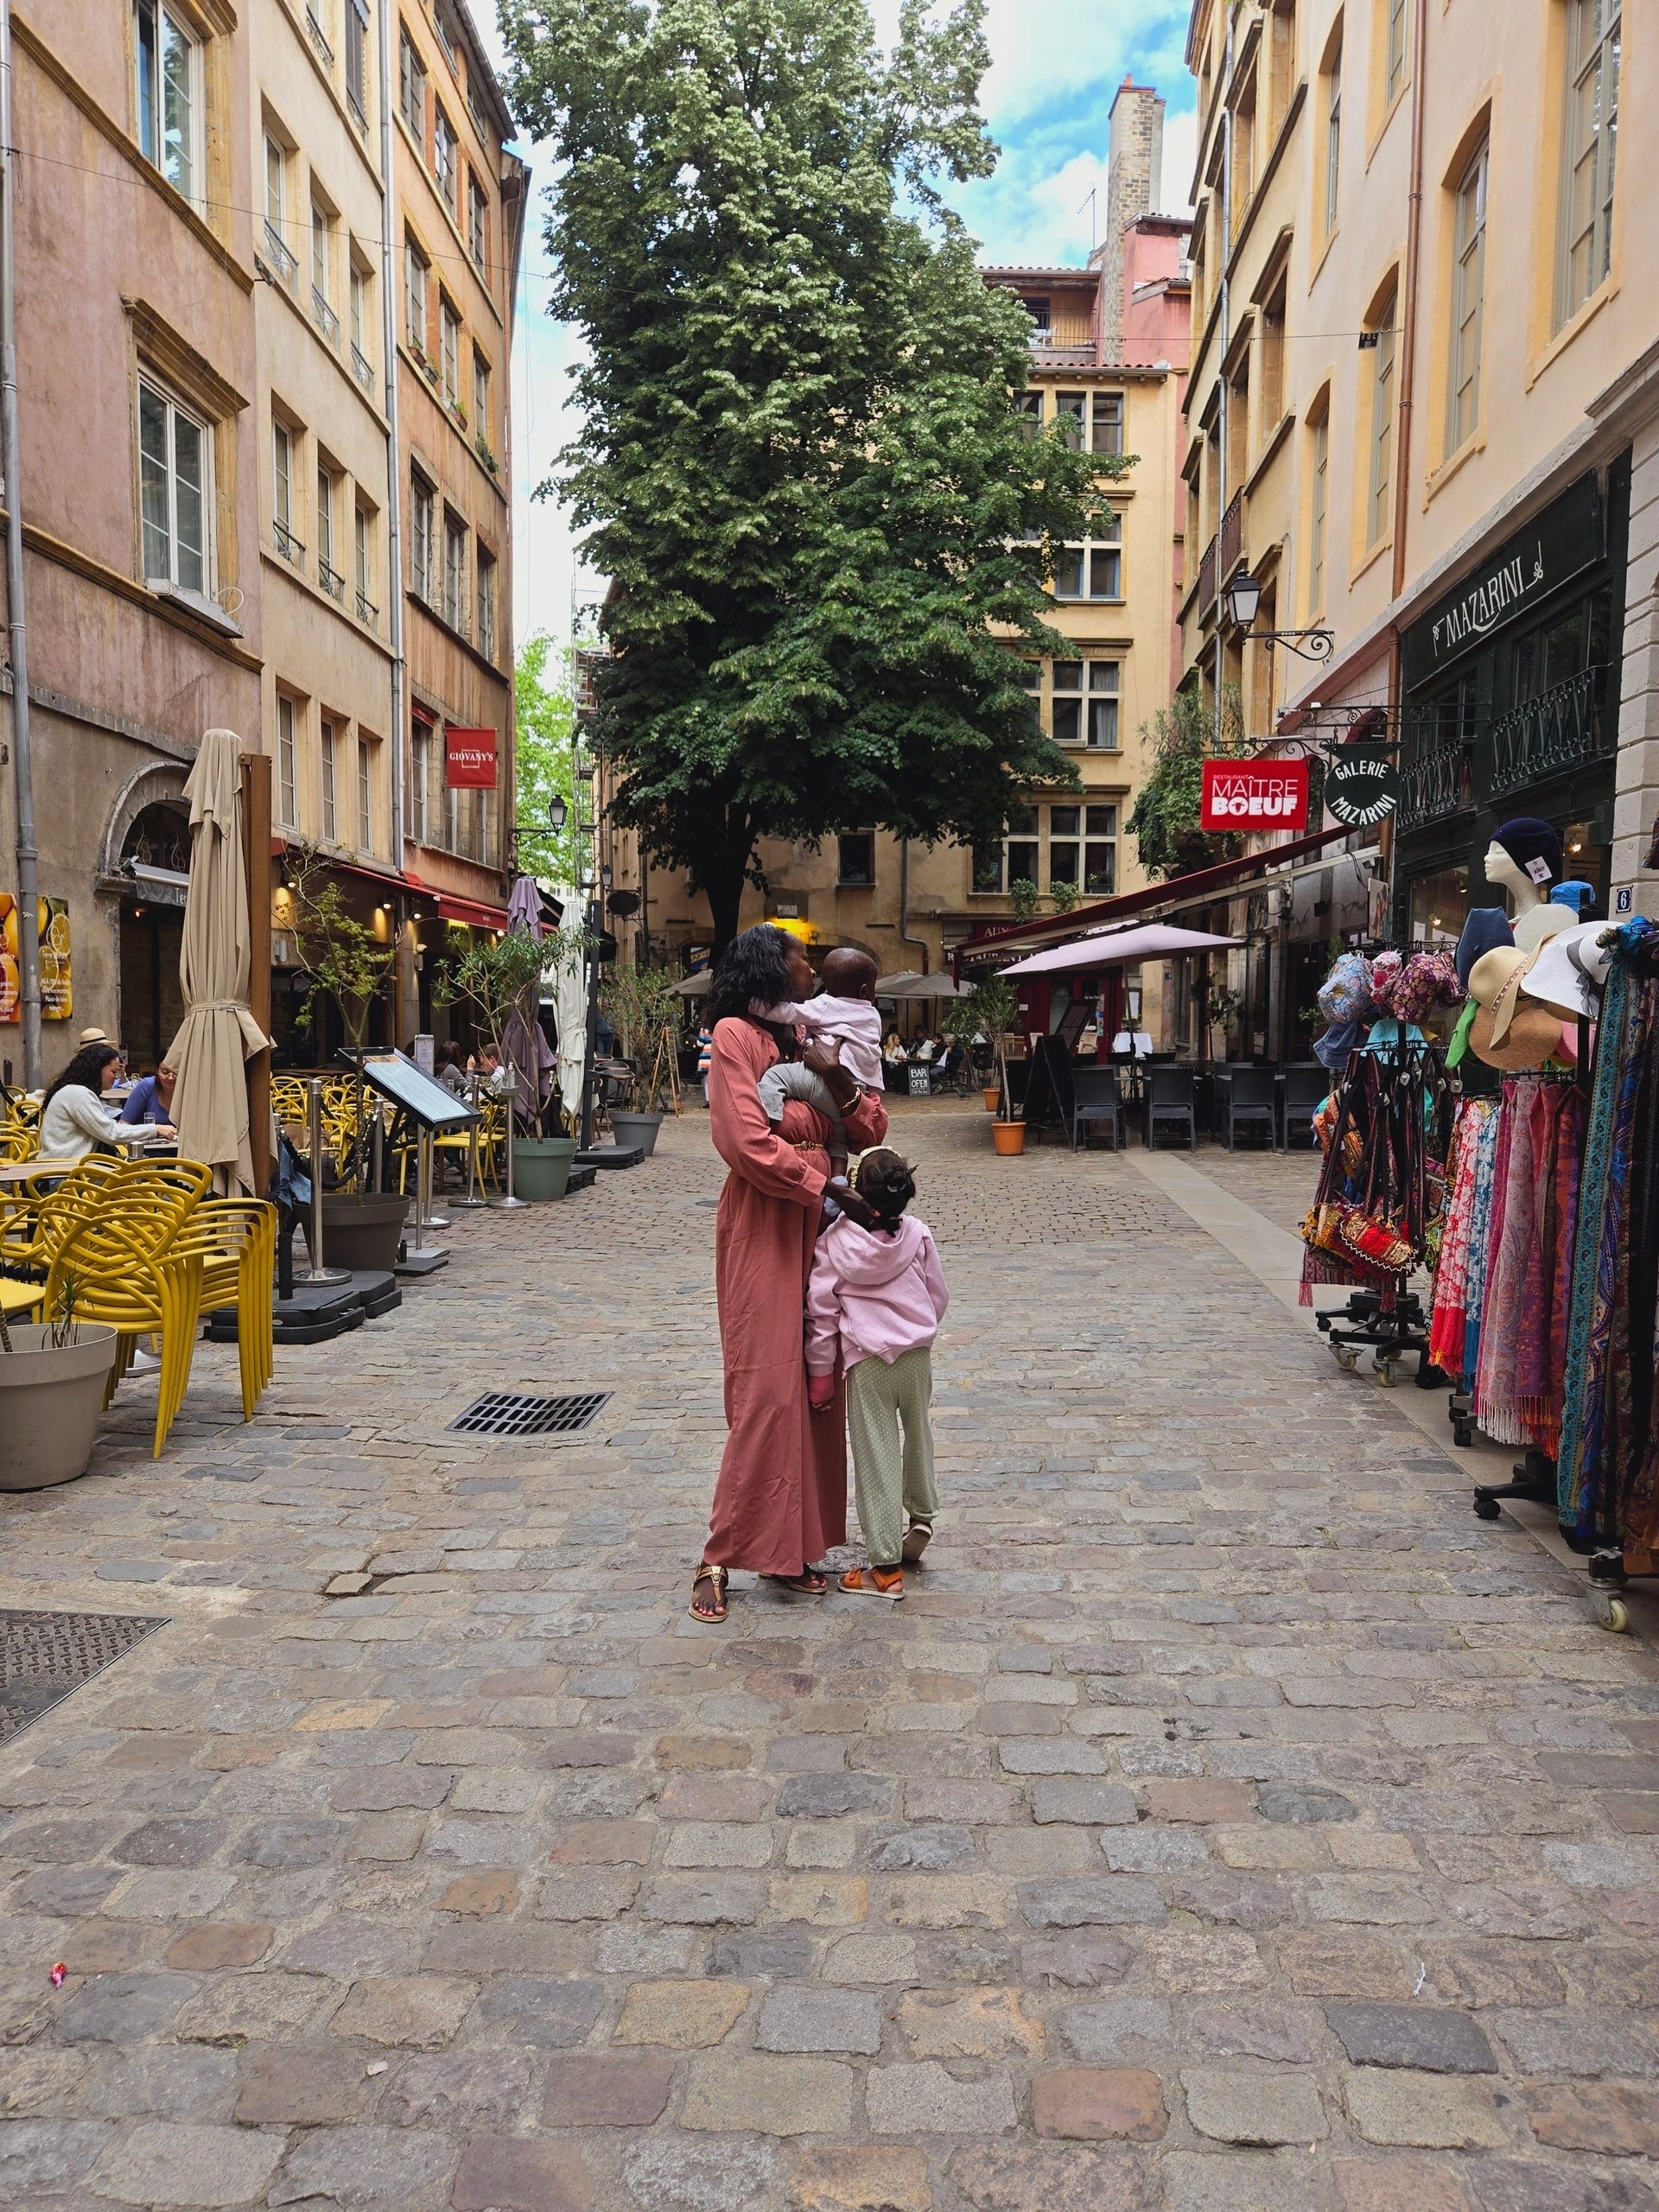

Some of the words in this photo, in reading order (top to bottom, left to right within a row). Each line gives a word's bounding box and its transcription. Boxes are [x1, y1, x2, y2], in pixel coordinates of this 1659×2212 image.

[1446, 556, 1525, 647] MAZARINI
[449, 751, 493, 762] GIOVANY'S
[1334, 760, 1389, 780] GALERIE
[1211, 775, 1299, 798] MAÎTRE
[1211, 796, 1298, 816] BOEUF
[1330, 793, 1397, 826] MAZARINI
[1620, 891, 1627, 909] 6
[911, 1068, 927, 1078] BAR
[911, 1078, 928, 1088] OPEN
